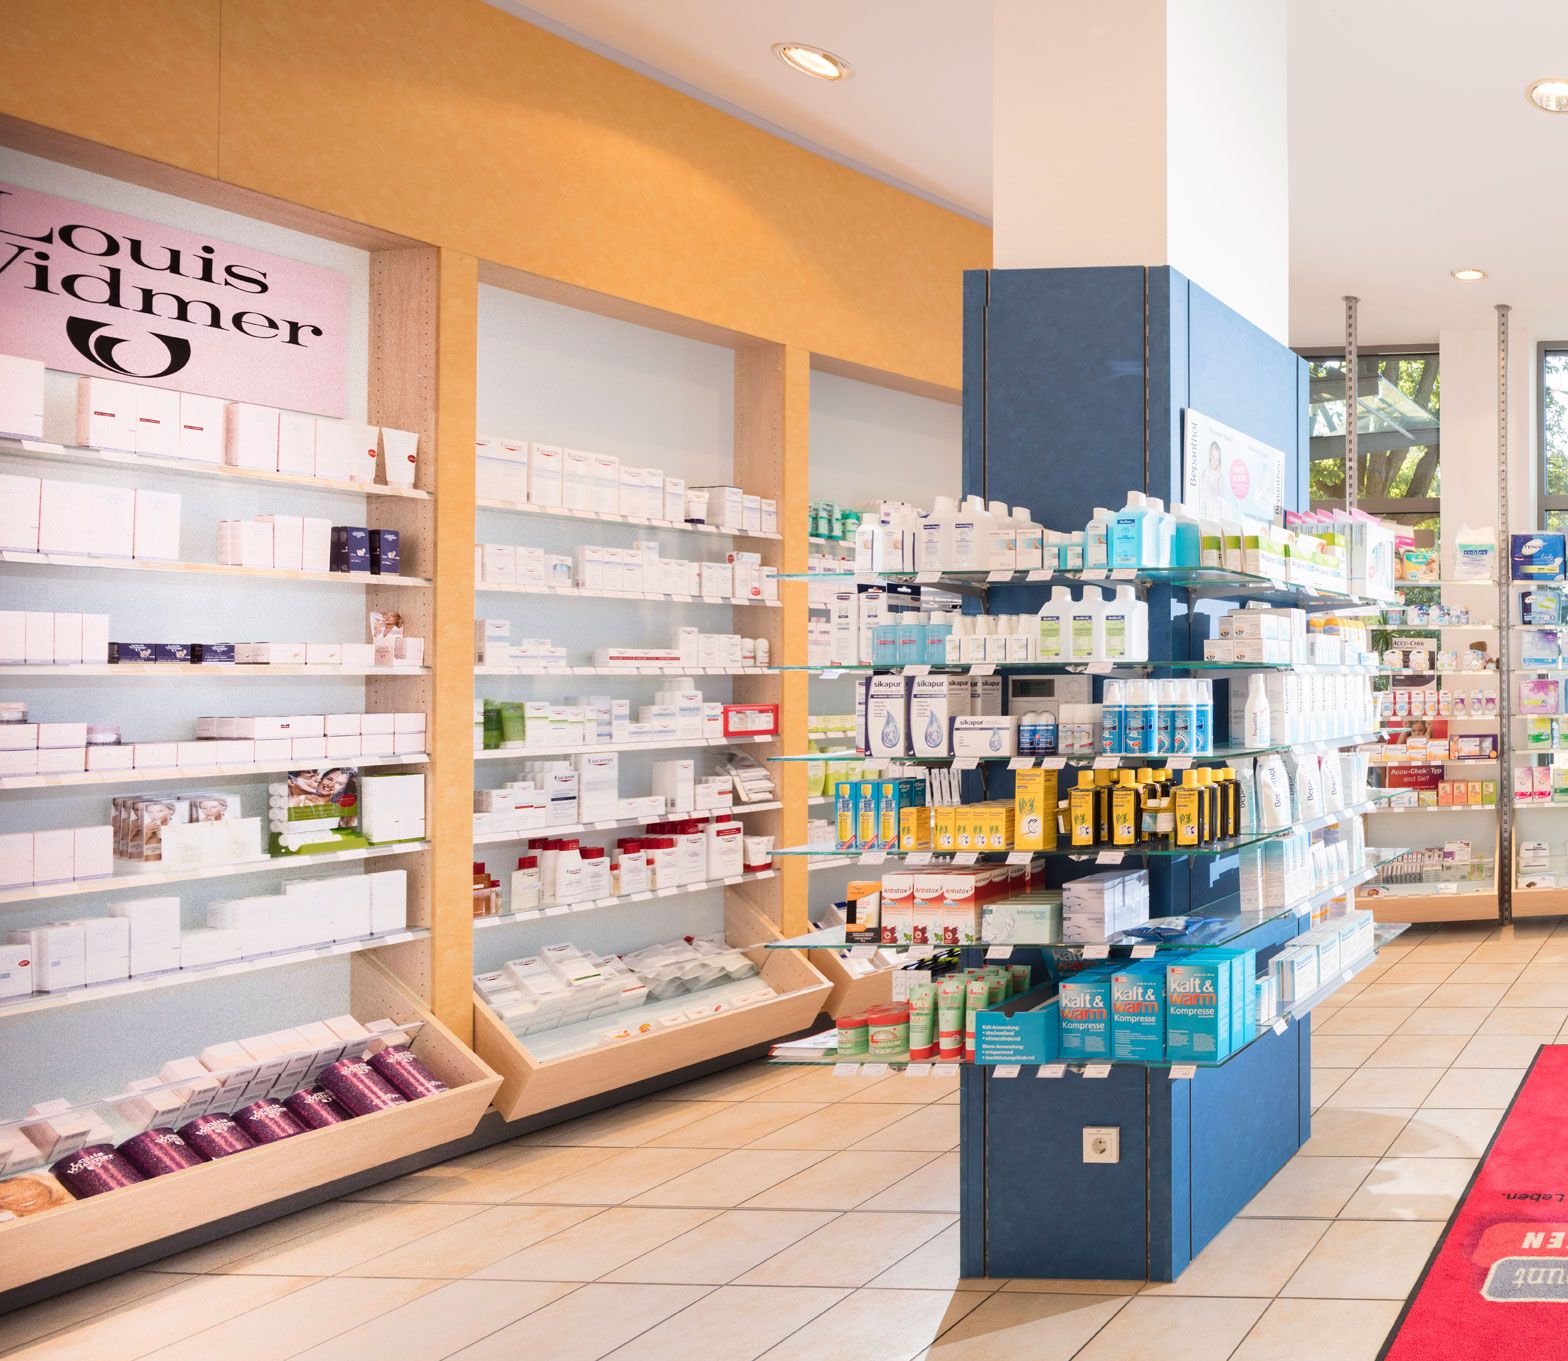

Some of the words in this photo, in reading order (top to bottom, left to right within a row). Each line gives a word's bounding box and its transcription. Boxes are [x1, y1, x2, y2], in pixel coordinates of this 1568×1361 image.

[1189, 422, 1198, 487] Bepanthol
[873, 679, 902, 689] sikapur
[916, 679, 945, 689] sikapur
[959, 719, 985, 727] sikapur
[1430, 767, 1442, 775] Typ
[884, 886, 907, 894] Antistax
[915, 886, 938, 894] Antistax
[945, 887, 969, 895] Antistax
[1170, 976, 1201, 993] kalt
[1203, 979, 1215, 993] &
[1113, 985, 1143, 1001] kalt
[1144, 988, 1156, 1001] &
[1062, 993, 1091, 1008] kalt
[1093, 995, 1105, 1008] &
[1169, 993, 1217, 1006] warm
[1113, 1001, 1159, 1013] warm
[1170, 1006, 1215, 1016] Kompresse
[1060, 1008, 1107, 1020] warm
[1114, 1014, 1156, 1024] Kompresse
[1062, 1021, 1105, 1030] Kompresse
[1501, 1191, 1566, 1204] Leben.
